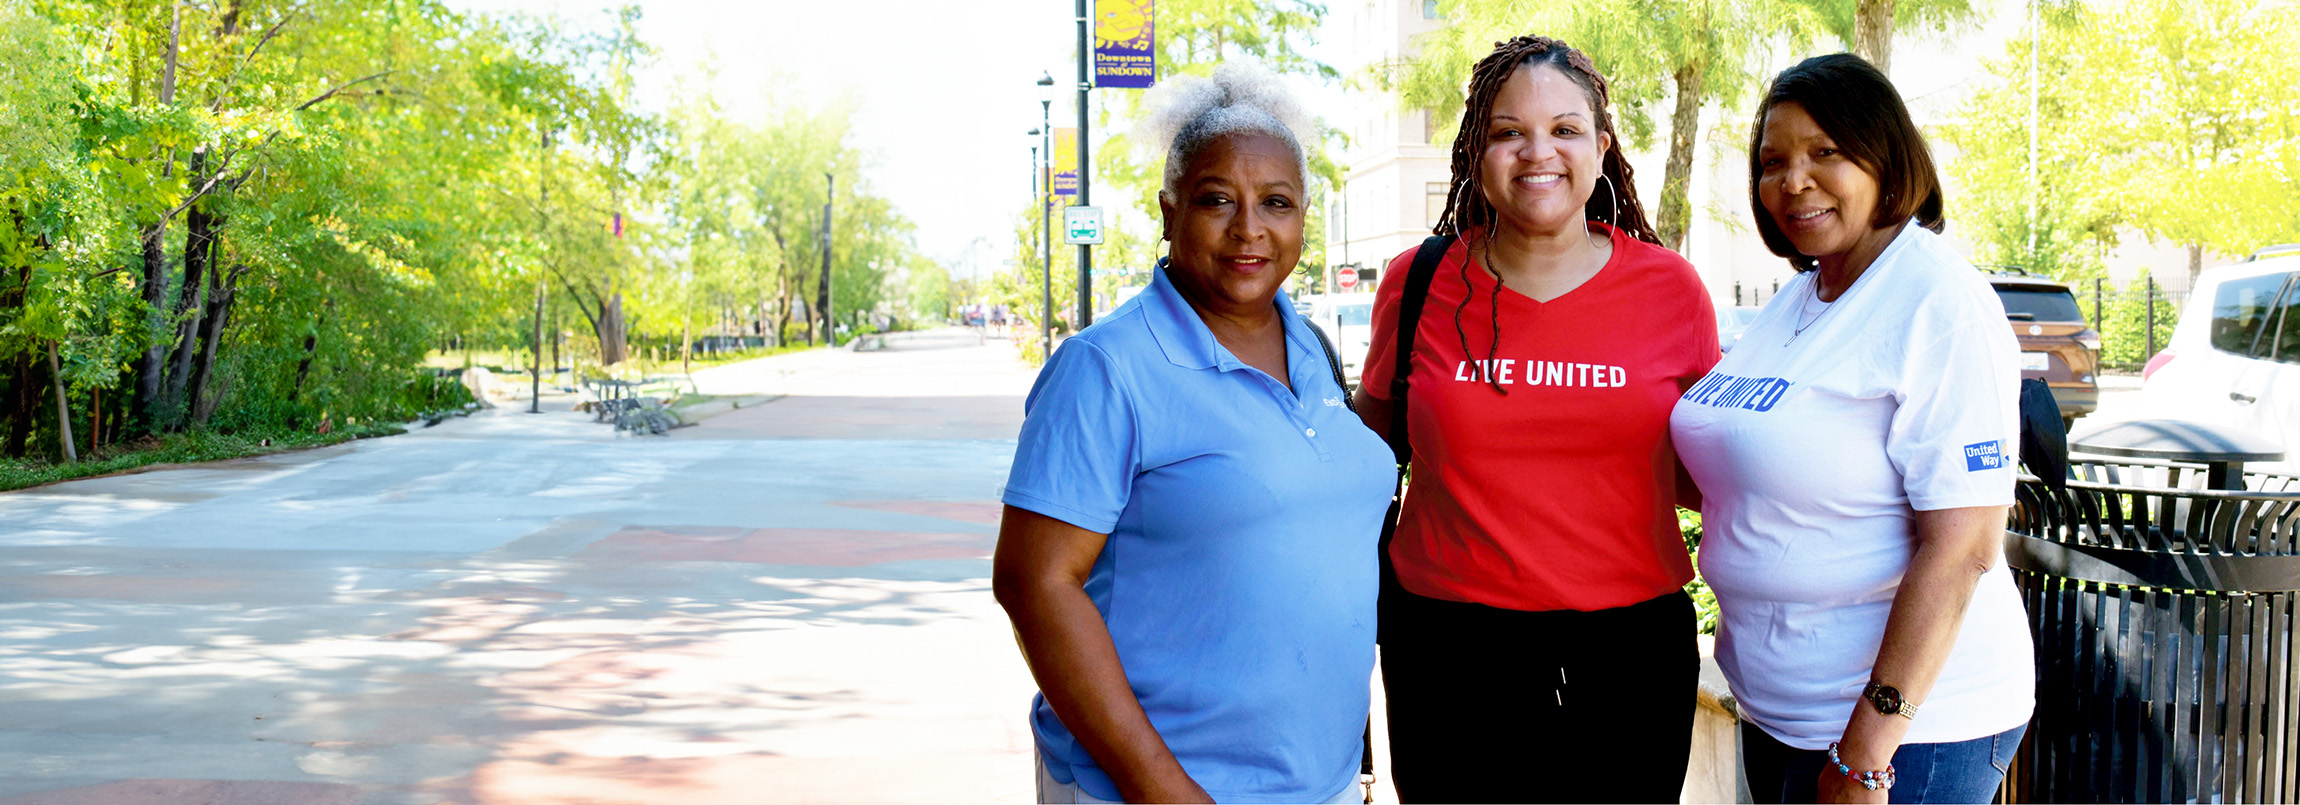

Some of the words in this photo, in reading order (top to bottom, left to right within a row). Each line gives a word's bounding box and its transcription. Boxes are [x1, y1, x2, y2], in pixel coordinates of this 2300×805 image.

[1096, 53, 1152, 62] Downtown
[1096, 67, 1152, 76] SUNDOWN
[1339, 273, 1357, 284] STOP
[1526, 360, 1627, 388] UNITED
[1712, 377, 1790, 412] UNITED
[1965, 442, 1999, 457] United
[1980, 455, 1999, 467] Way
